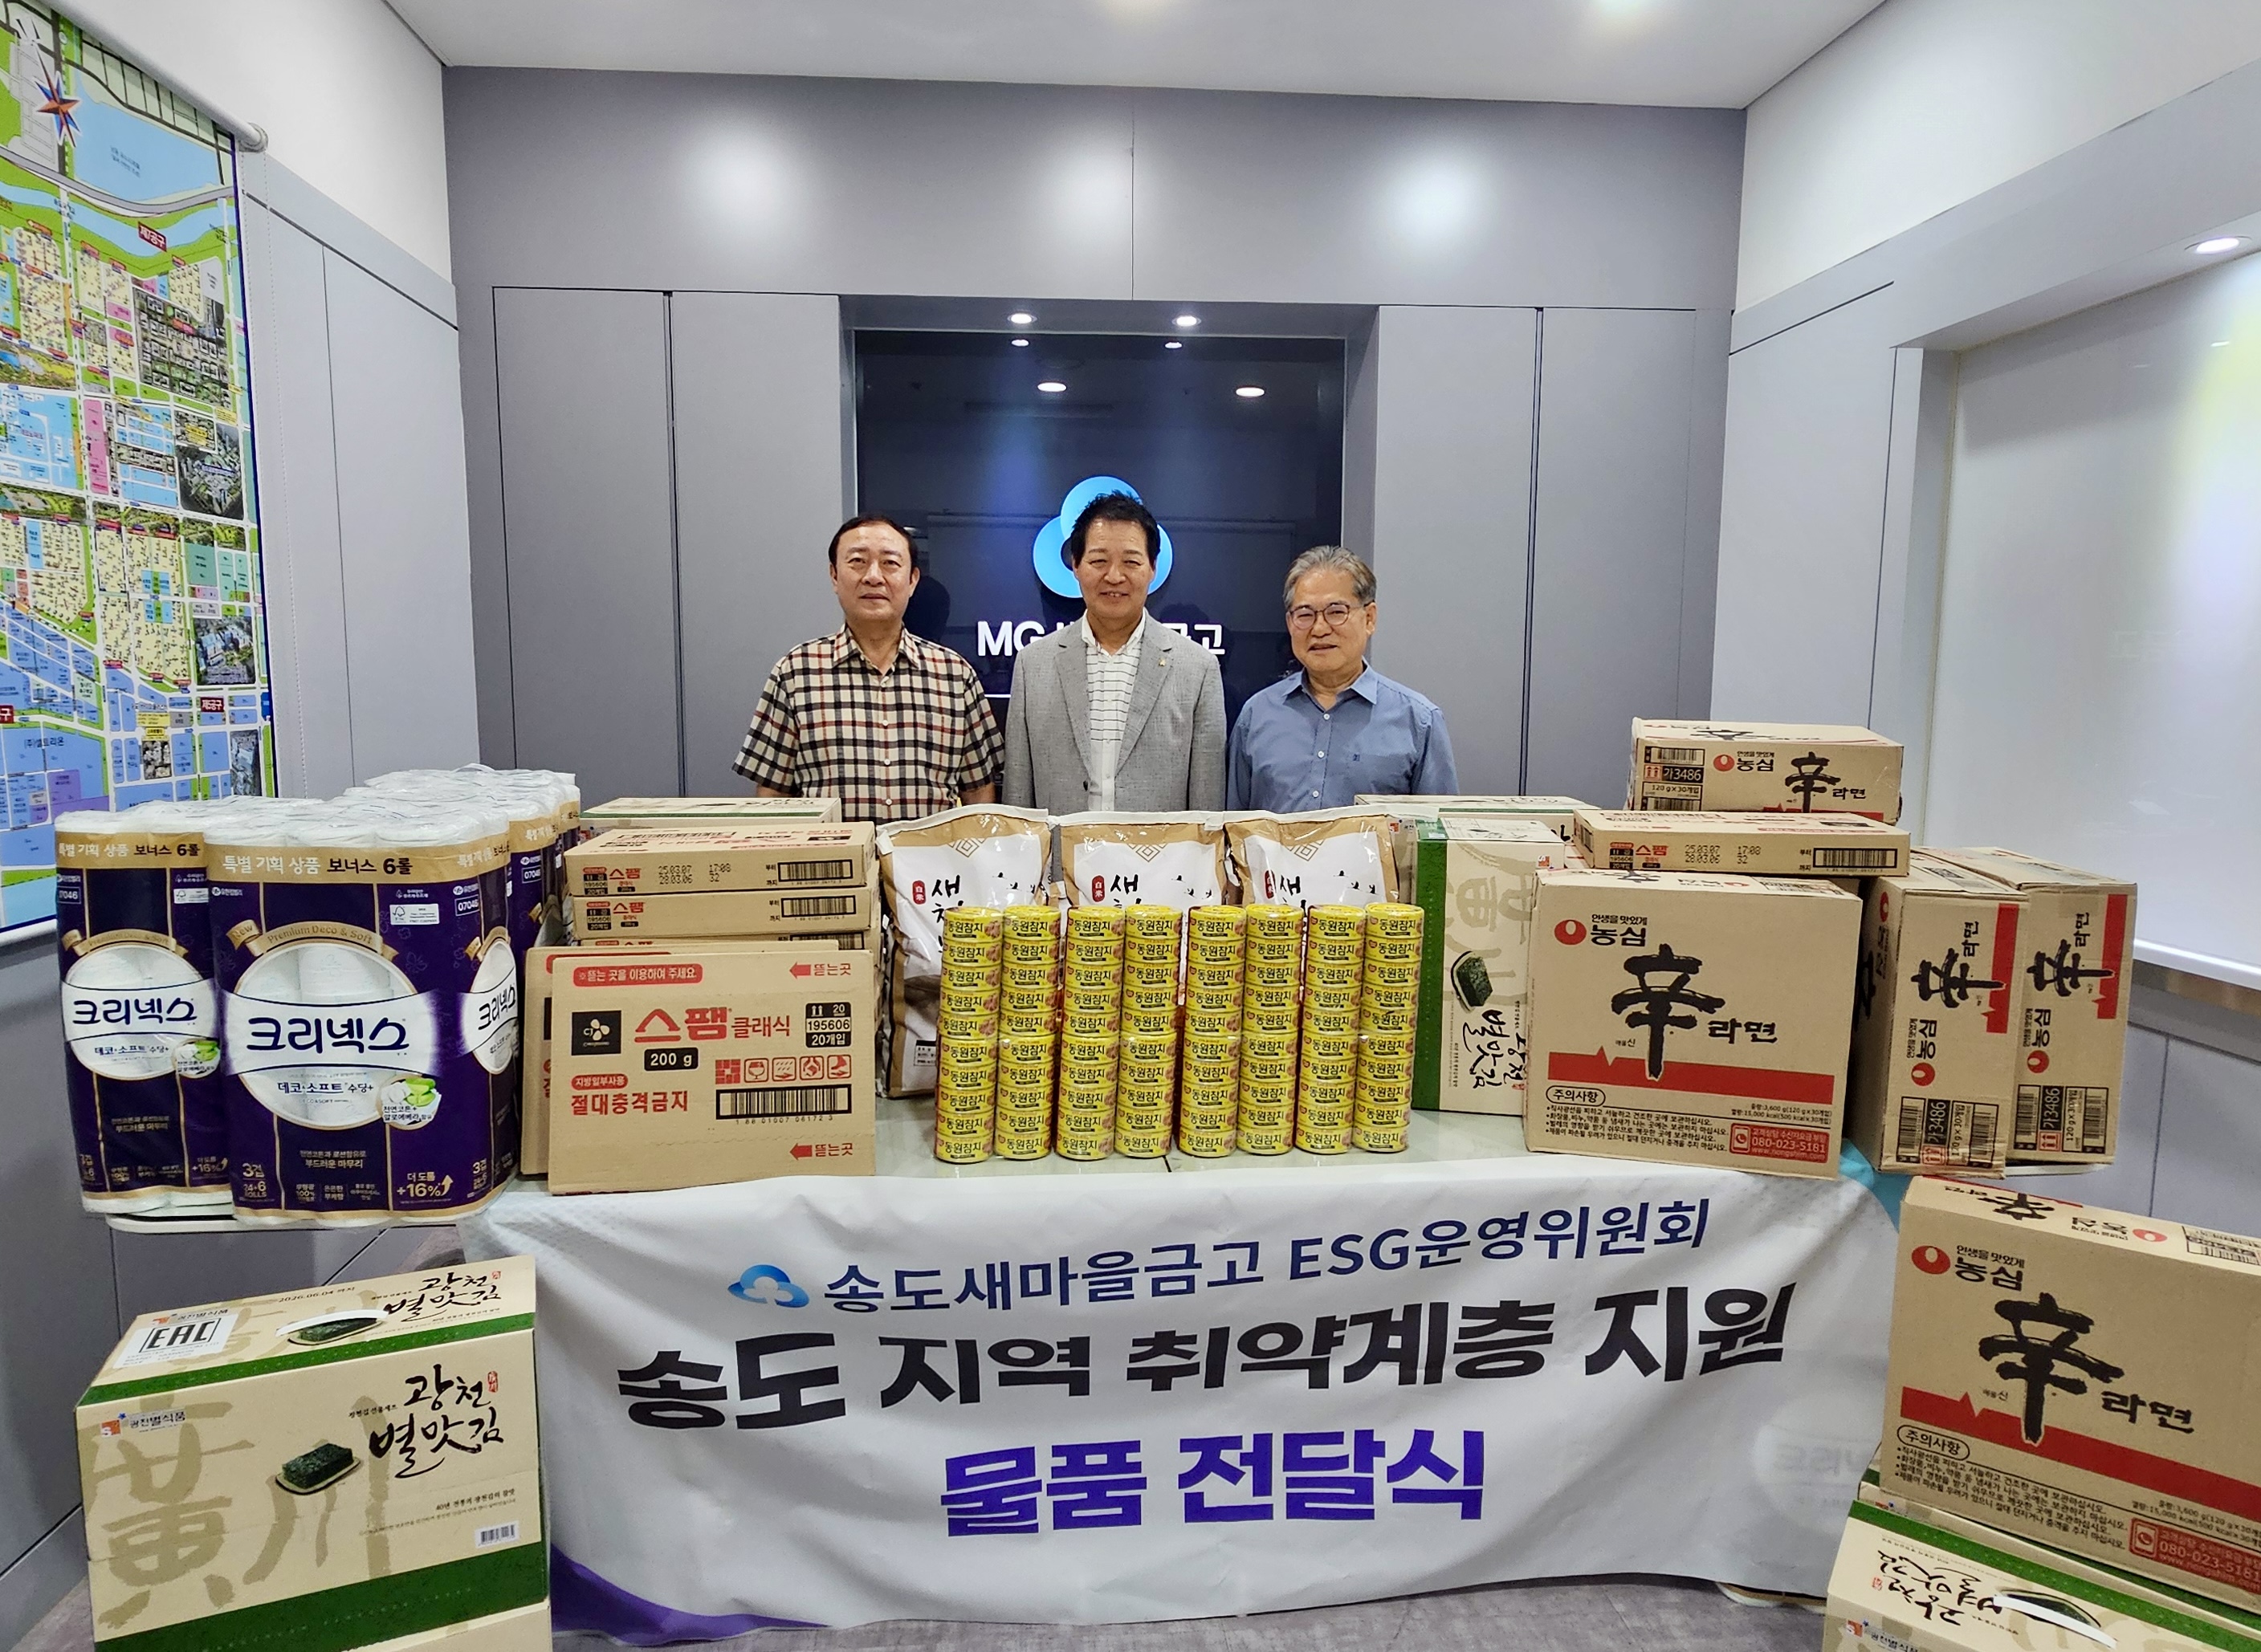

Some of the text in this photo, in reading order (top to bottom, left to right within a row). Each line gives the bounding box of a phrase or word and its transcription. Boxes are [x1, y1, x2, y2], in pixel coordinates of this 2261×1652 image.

[1663, 766, 1702, 783] 가3486
[1736, 757, 1774, 772] 농심
[1784, 751, 1841, 813] 辛
[1831, 787, 1867, 800] 라면
[78, 844, 100, 857] 기획
[104, 844, 129, 857] 상품
[133, 844, 172, 857] 보너스
[177, 844, 201, 857] 6롤
[1635, 844, 1669, 857] 스팸
[1737, 855, 1748, 865] 32
[222, 855, 413, 876] 특별 기획 상품 보너스 6롤
[609, 867, 642, 880] 스팸
[613, 901, 644, 913] 스팸
[1591, 913, 1648, 926] 인생을 맛있게
[267, 925, 373, 946] Premium Deco & Soft
[1590, 924, 1647, 947] 농심
[608, 968, 626, 982] 곳을
[629, 968, 666, 981] 이용하여
[668, 966, 698, 979] 주세요.
[813, 962, 852, 977] 뜯는곳
[72, 997, 198, 1025] 크리넥스
[1611, 943, 1725, 1078] 辛
[246, 1016, 409, 1054] 크리넥스
[634, 1006, 791, 1044] 스팸 클래식
[807, 1019, 851, 1031] 195606
[1708, 1017, 1778, 1044] 라면
[2031, 1008, 2052, 1048] 농심
[811, 1033, 846, 1046] 20개입
[1916, 1019, 1937, 1060] 농심
[650, 1052, 693, 1068] 200 g
[574, 1076, 625, 1088] 지방일부사용
[570, 1090, 689, 1117] 절대충격금지
[1552, 1089, 1599, 1103] 주의사항
[814, 1143, 853, 1158] 뜯는곳
[1751, 1137, 1826, 1154] 080-023-5181
[242, 1163, 265, 1179] 3겹
[305, 1159, 364, 1169] 부드러운 마무리
[397, 1182, 441, 1198] +16%
[824, 1197, 1710, 1313] 송도새마을금고 ESG운영위원회
[1956, 1244, 2026, 1269] 인생을 맛있게
[422, 1272, 490, 1292] 광천
[1954, 1256, 2023, 1292] 농심
[384, 1284, 502, 1323] 별맛김
[617, 1282, 1798, 1430] 송도 지역 취약계층 지원
[1978, 1292, 2125, 1442] 辛
[403, 1364, 491, 1411] 광천
[2100, 1391, 2194, 1434] 라면
[369, 1406, 504, 1479] 별맛김
[1905, 1429, 1962, 1456] 주의사항
[940, 1430, 1485, 1537] 물품 전달식
[2160, 1540, 2261, 1583] 080-023-5181
